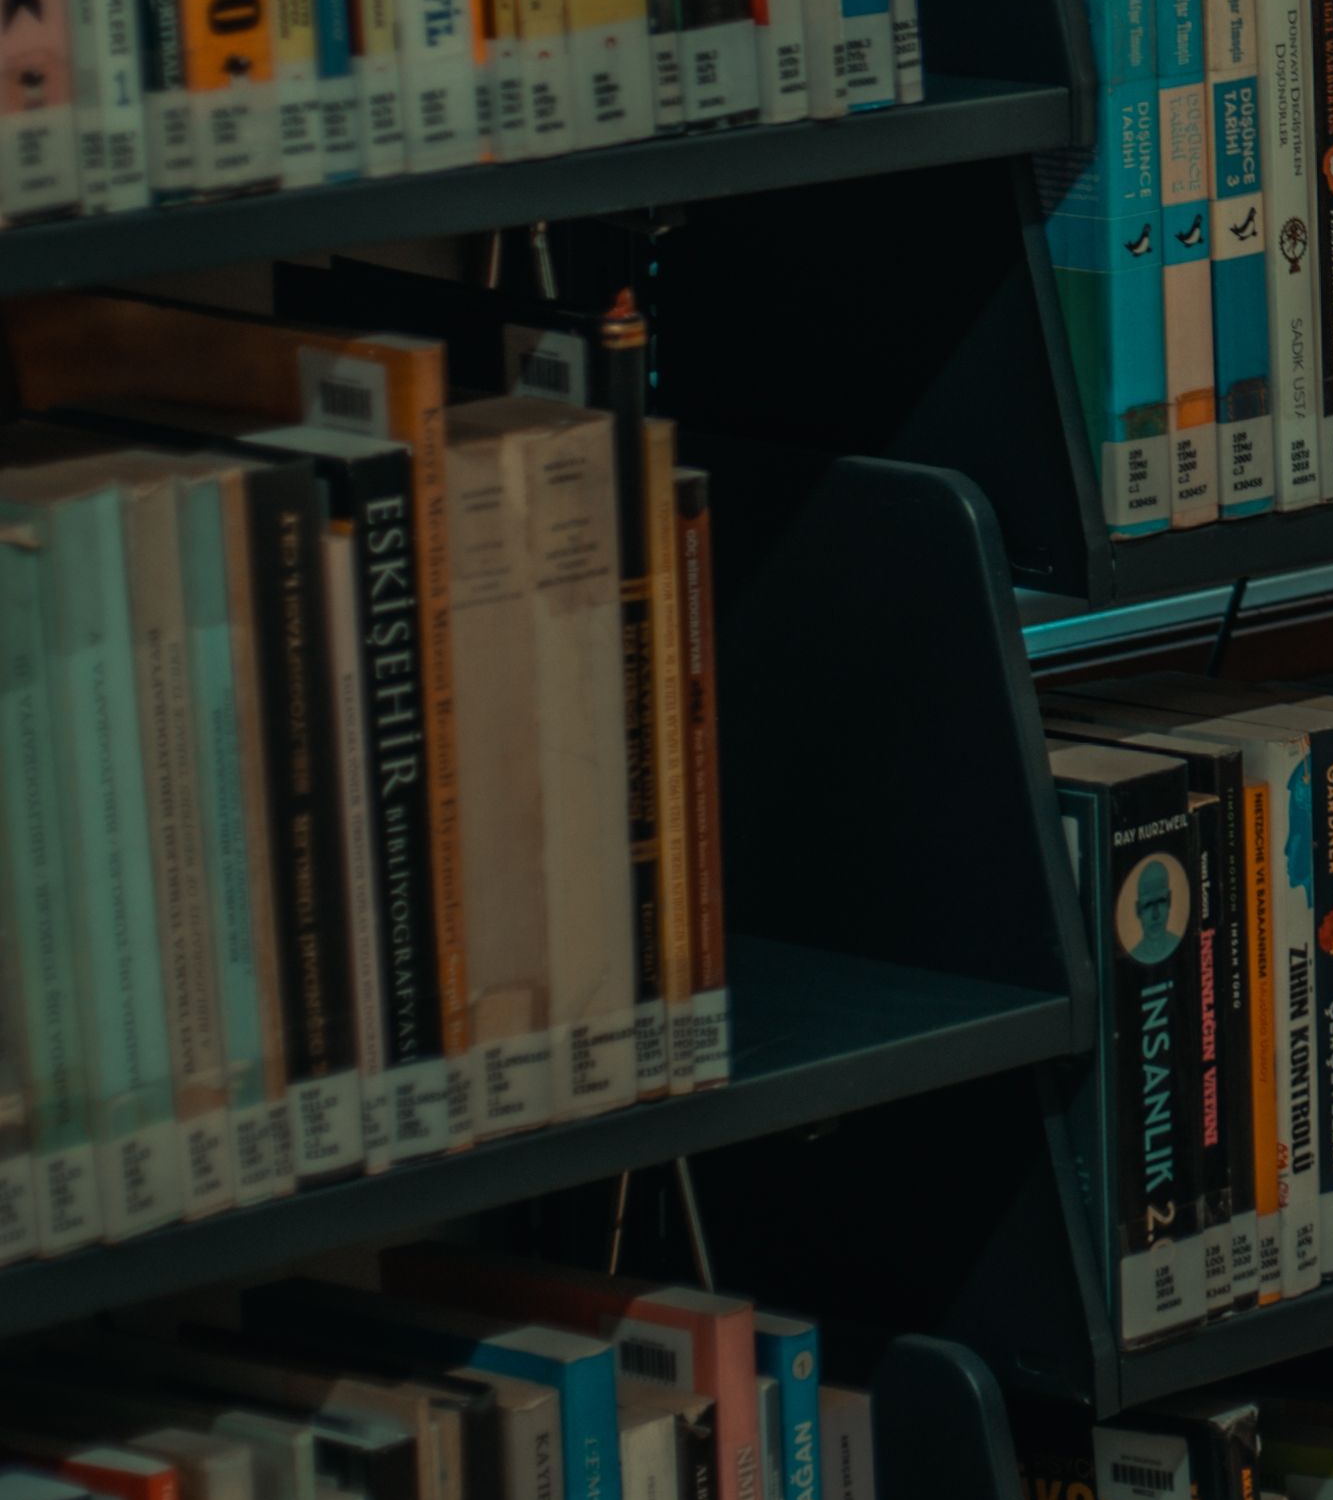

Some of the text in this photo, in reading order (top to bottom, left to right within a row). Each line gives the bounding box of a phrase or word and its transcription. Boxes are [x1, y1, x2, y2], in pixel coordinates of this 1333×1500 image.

[1224, 91, 1242, 155] TARİHİ
[1239, 88, 1255, 185] DÜŞÜNCE
[361, 495, 423, 799] ESKİŞEHİR
[1141, 980, 1176, 1192] İNSANLIK
[1292, 1028, 1313, 1174] KONTROLÜ
